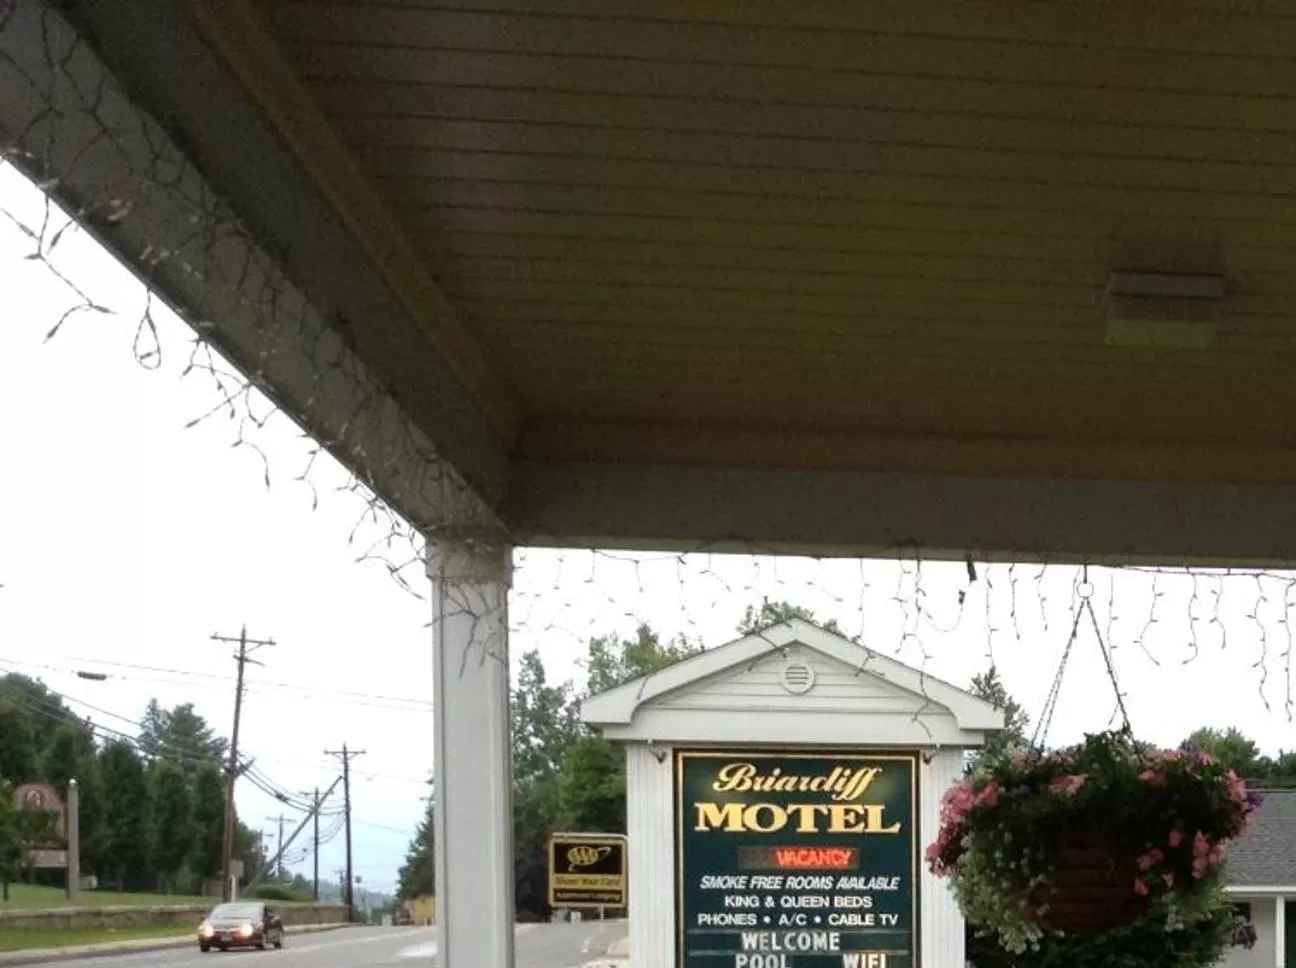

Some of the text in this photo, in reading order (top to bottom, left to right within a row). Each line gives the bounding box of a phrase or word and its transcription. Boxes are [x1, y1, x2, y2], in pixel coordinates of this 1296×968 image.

[712, 763, 883, 801] Briarcliff
[694, 802, 901, 834] MOTEL
[776, 850, 852, 866] VACANCY
[700, 875, 900, 891] SMOKE FREE ROOMS AVAILABLE
[724, 895, 873, 908] KING & QUEEN BEDS
[697, 913, 899, 926] PHONES A/C CABLE TV
[741, 932, 841, 951] WELCOME
